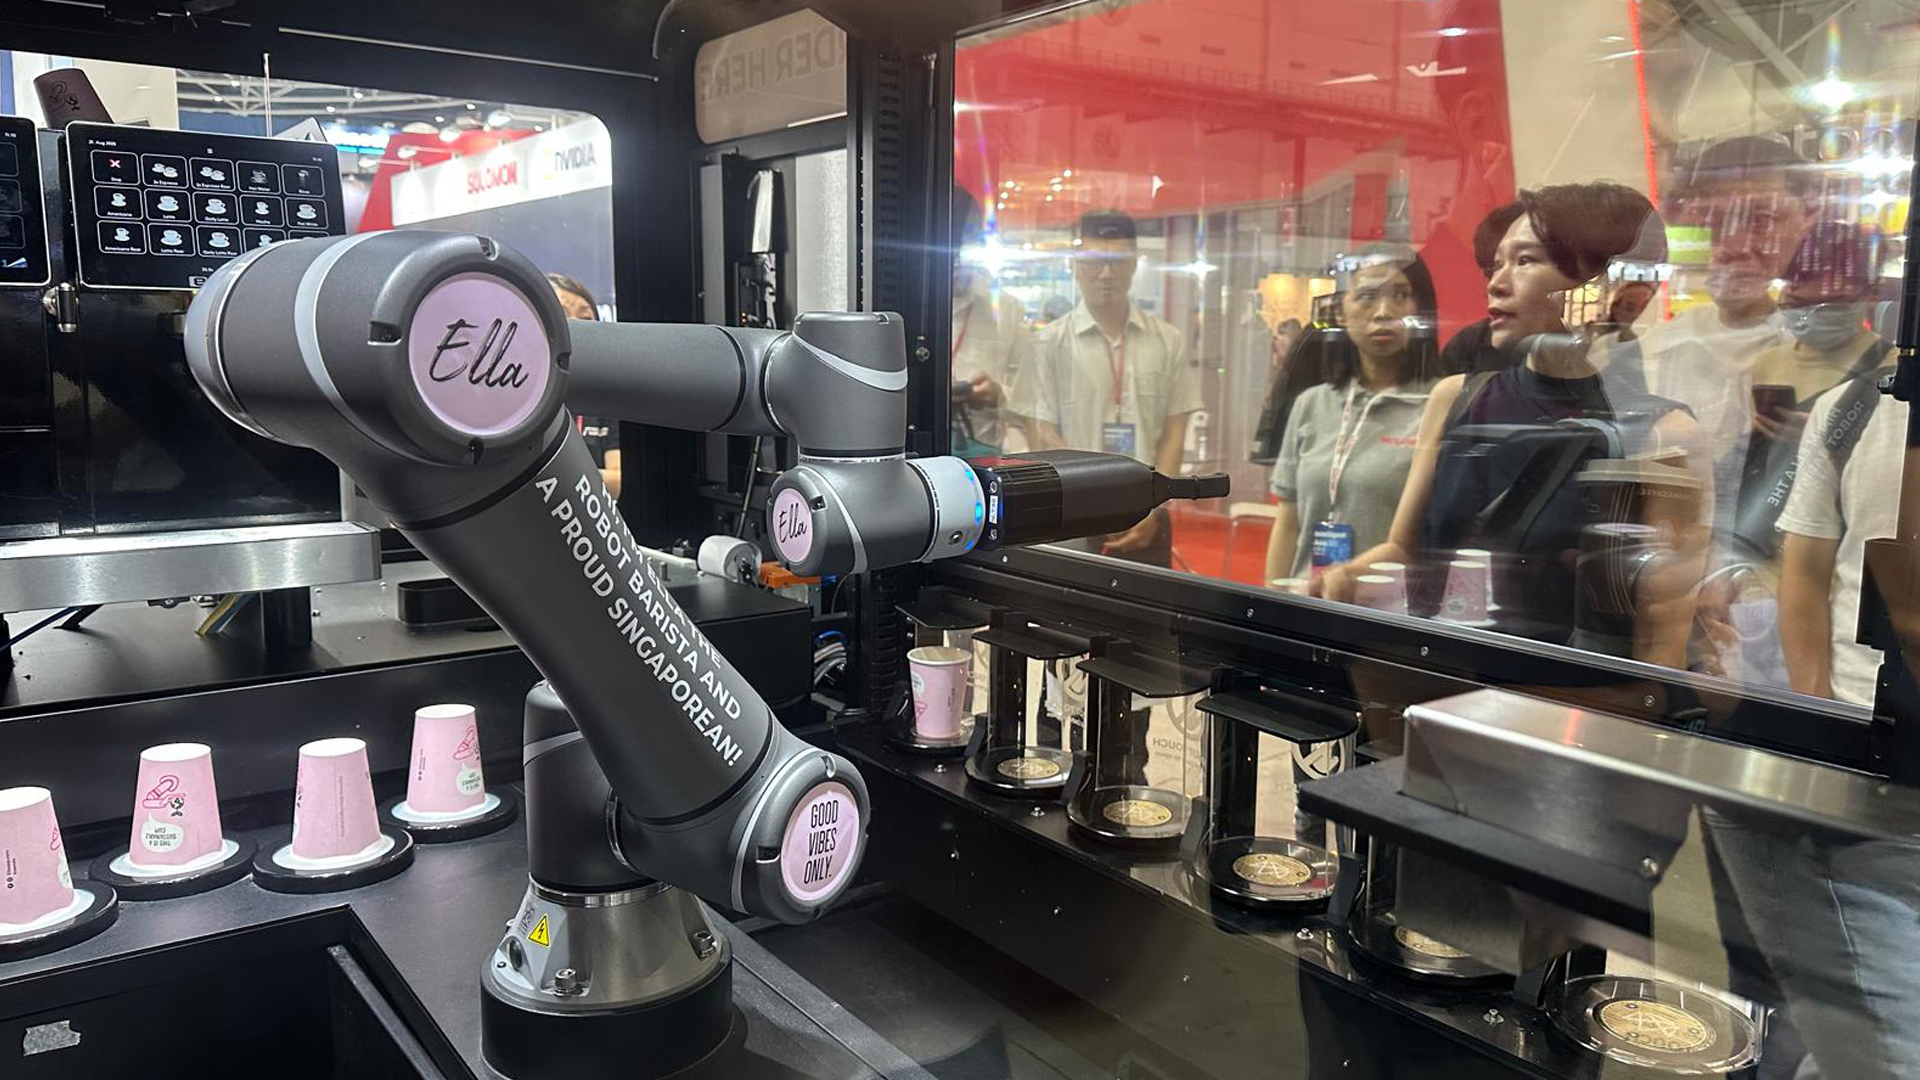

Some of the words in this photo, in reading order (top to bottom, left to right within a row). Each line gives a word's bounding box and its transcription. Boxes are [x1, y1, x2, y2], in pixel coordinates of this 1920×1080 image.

[429, 318, 529, 389] Ella
[778, 502, 808, 544] Ella
[535, 477, 558, 504] A
[551, 498, 615, 597] PROUD
[607, 597, 743, 767] SINGAPOREAN!
[575, 473, 632, 570] ROBOT
[628, 568, 699, 674] BARISTA
[699, 670, 741, 720] AND
[647, 561, 686, 627] ELLA
[689, 619, 722, 669] THE
[808, 827, 837, 857] VIBES
[810, 799, 839, 829] GOOD
[803, 855, 833, 885] ONLY.
